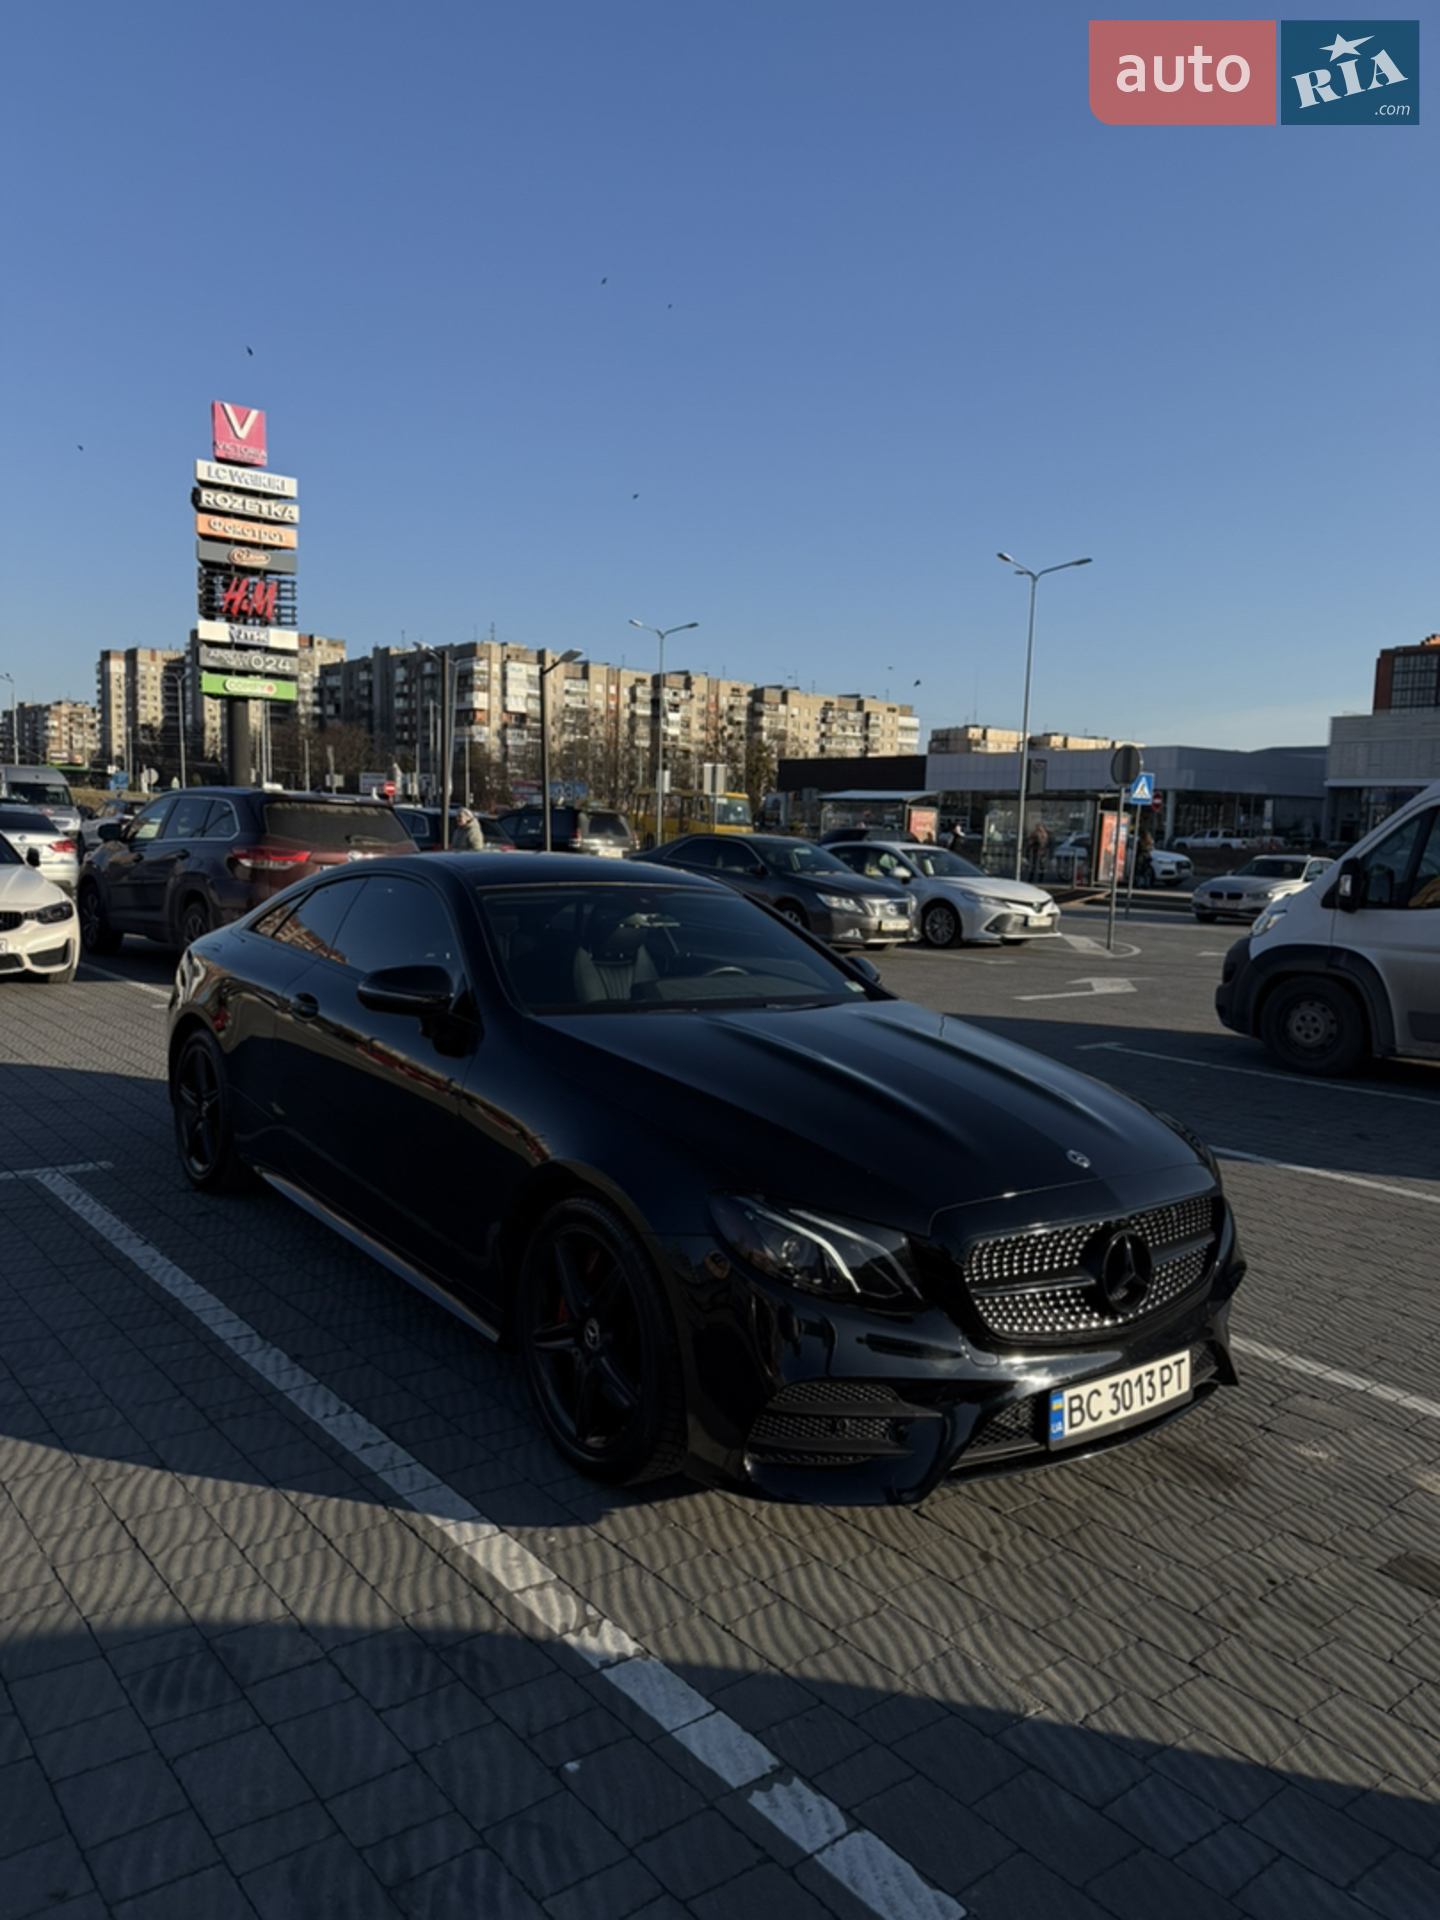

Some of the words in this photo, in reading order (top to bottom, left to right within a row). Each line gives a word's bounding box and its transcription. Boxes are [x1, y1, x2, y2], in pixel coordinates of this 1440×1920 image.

[200, 490, 296, 520] ROZETKA
[221, 576, 278, 622] H&M
[1068, 1388, 1103, 1429] BC
[1108, 1370, 1156, 1416] 3013
[1159, 1358, 1186, 1398] PT
